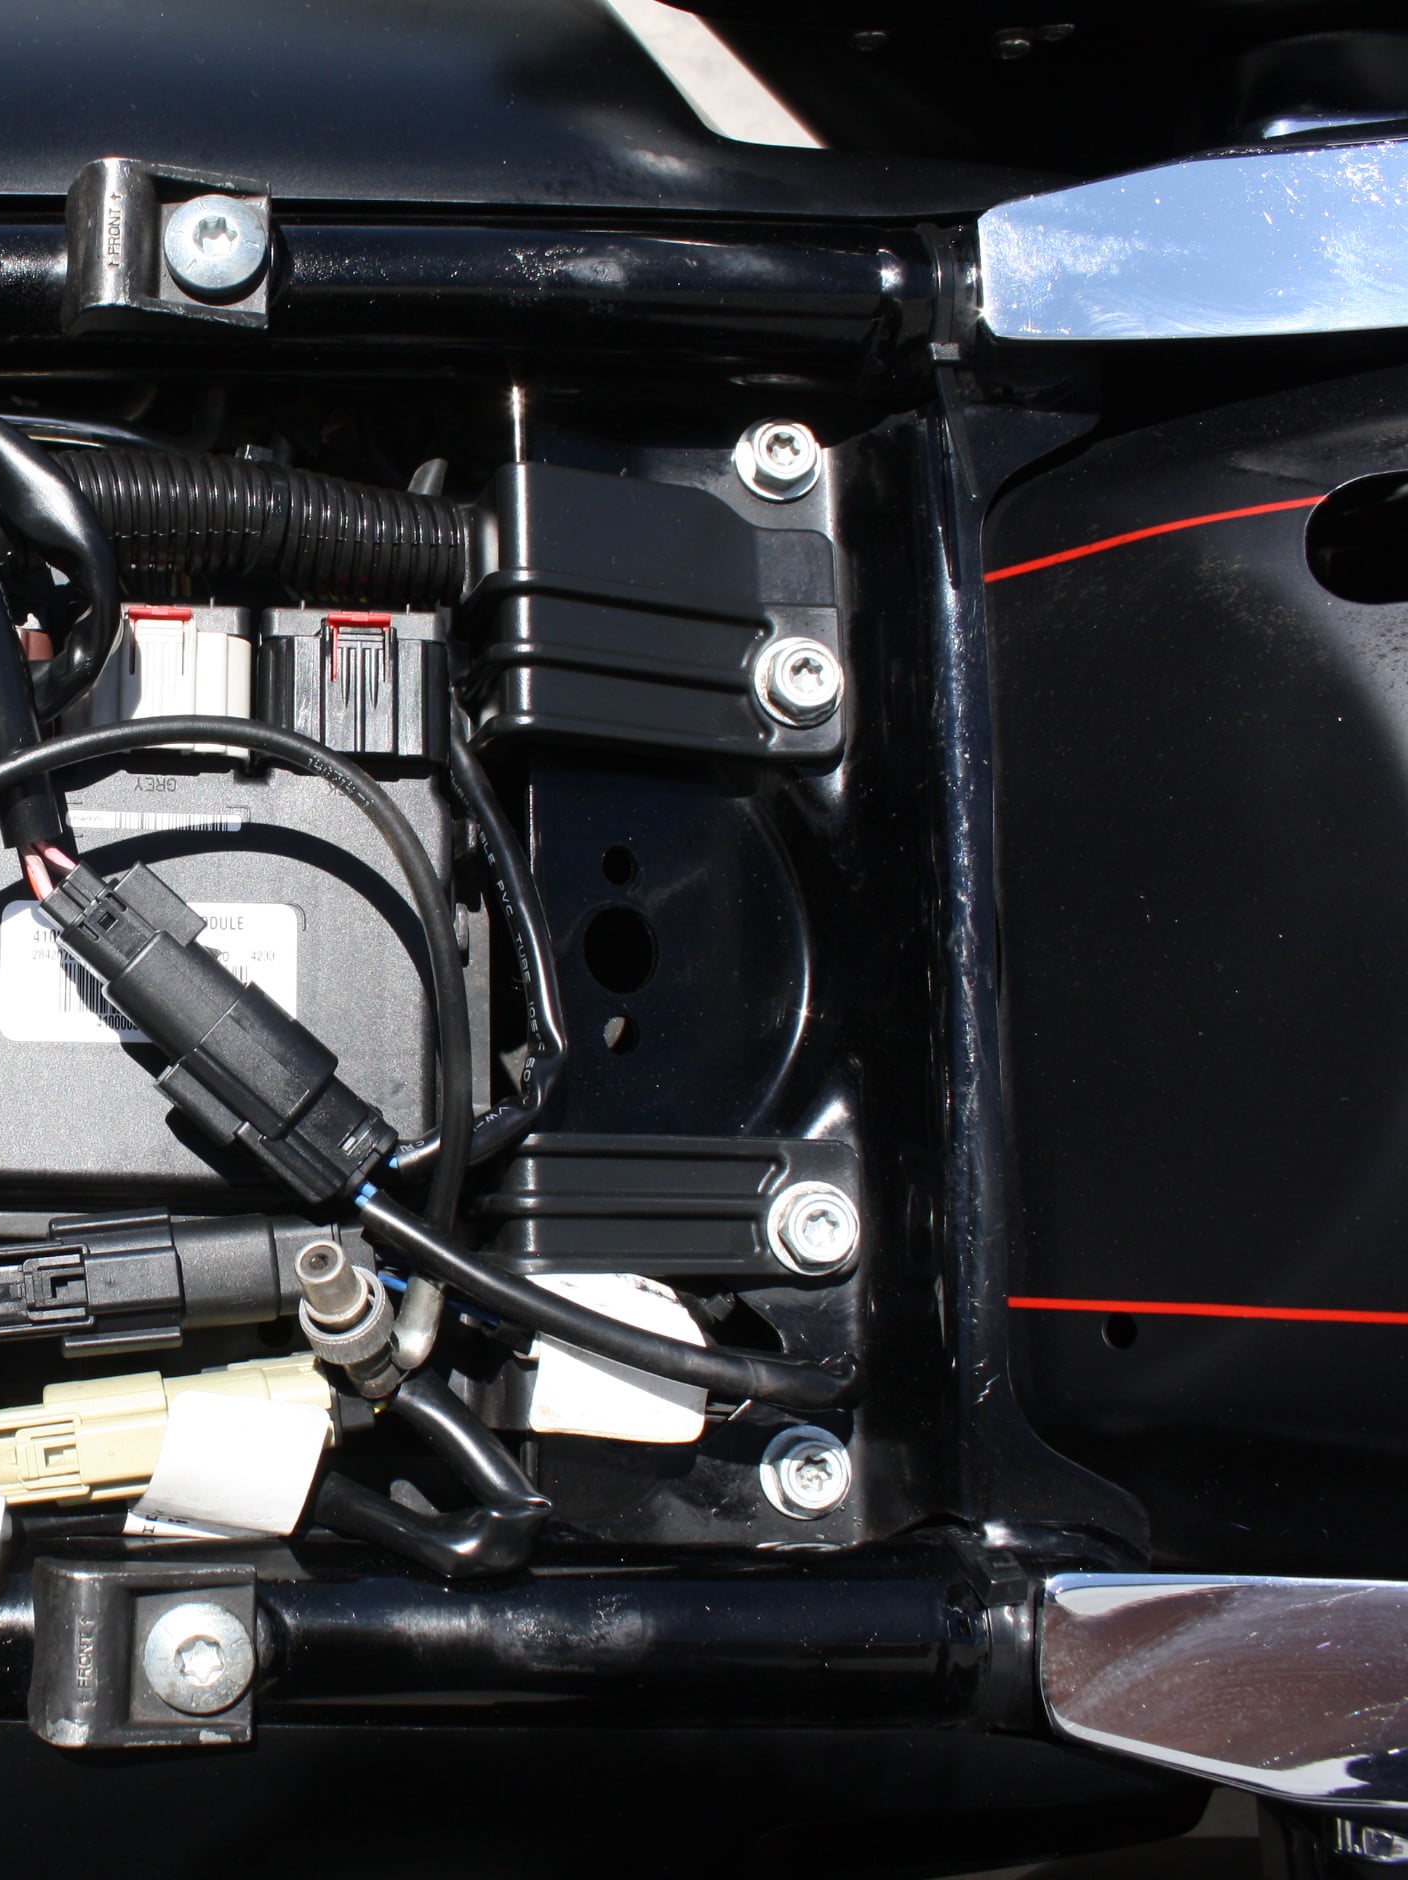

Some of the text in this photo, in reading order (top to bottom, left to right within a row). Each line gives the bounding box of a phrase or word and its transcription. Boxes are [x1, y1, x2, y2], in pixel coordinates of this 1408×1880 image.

[107, 207, 121, 256] FRONT
[133, 777, 177, 792] GREY
[495, 878, 514, 918] PVC
[515, 931, 531, 983] TUBE
[76, 1631, 93, 1688] FRONT
